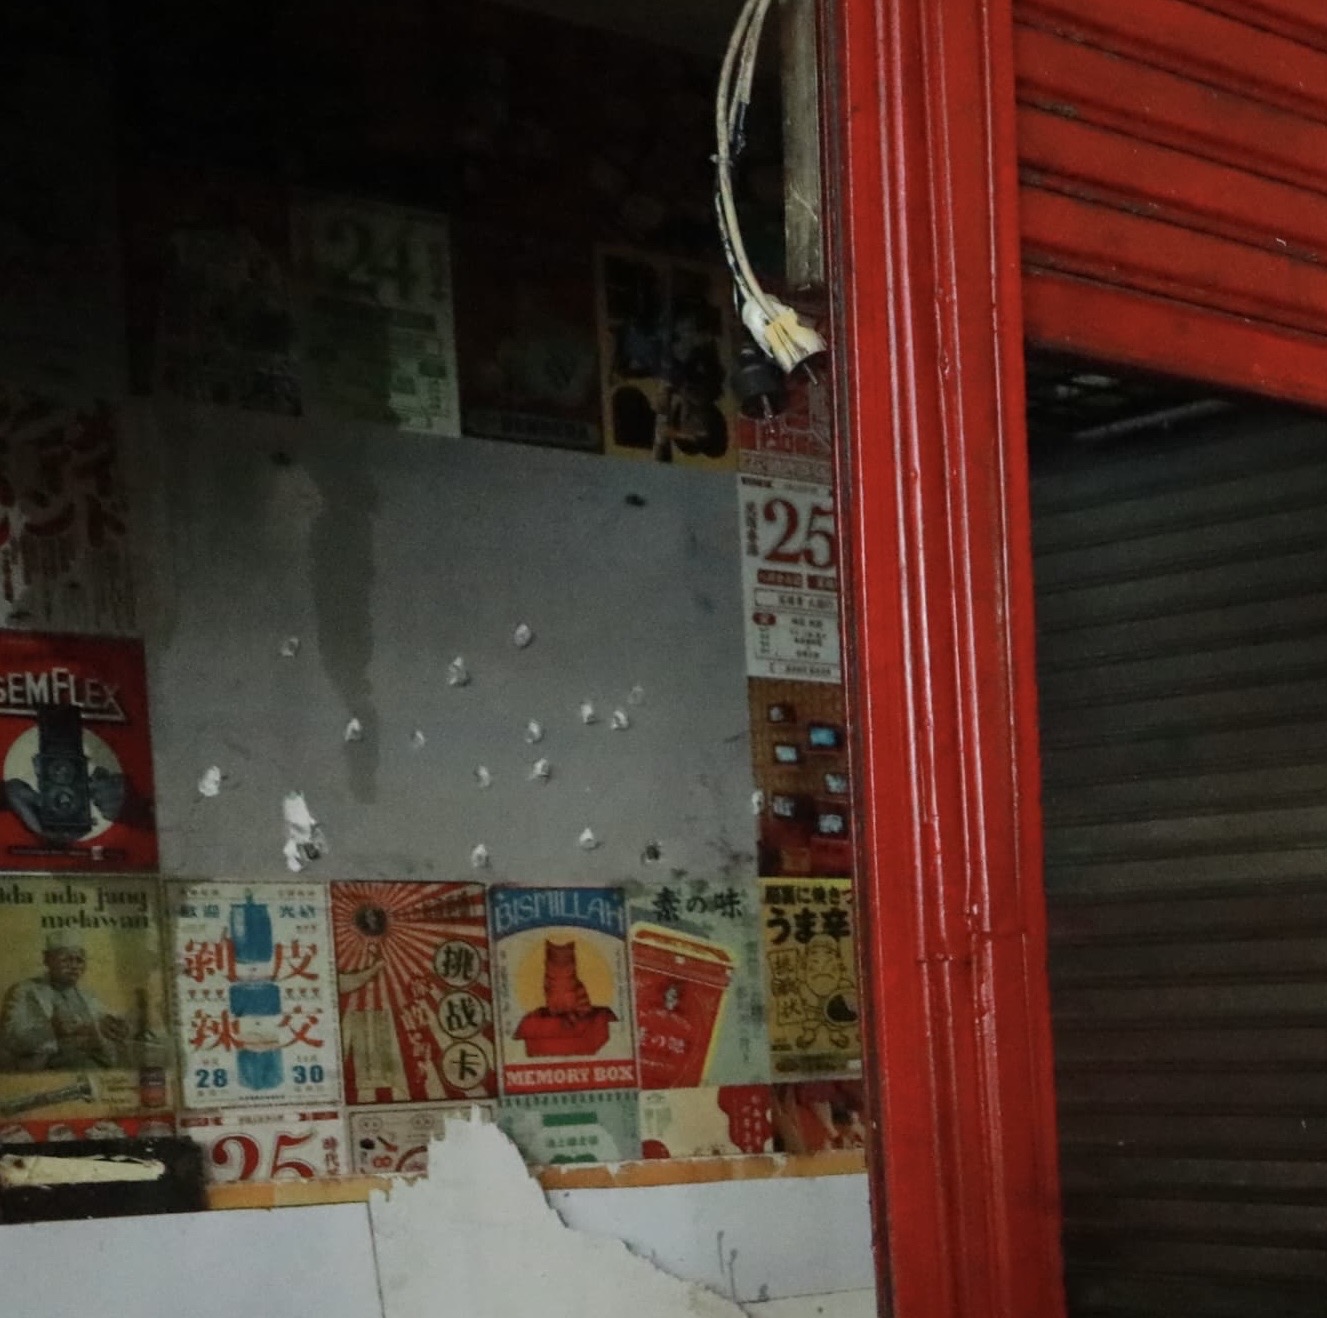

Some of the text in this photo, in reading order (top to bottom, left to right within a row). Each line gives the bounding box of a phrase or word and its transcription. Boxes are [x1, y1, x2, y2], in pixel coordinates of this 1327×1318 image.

[763, 498, 834, 570] 25
[41, 909, 149, 928] melawan
[496, 890, 624, 933] BISMILLAH
[195, 1069, 228, 1088] 28
[293, 1065, 324, 1084] 30
[506, 1064, 634, 1087] MEMORY BOX
